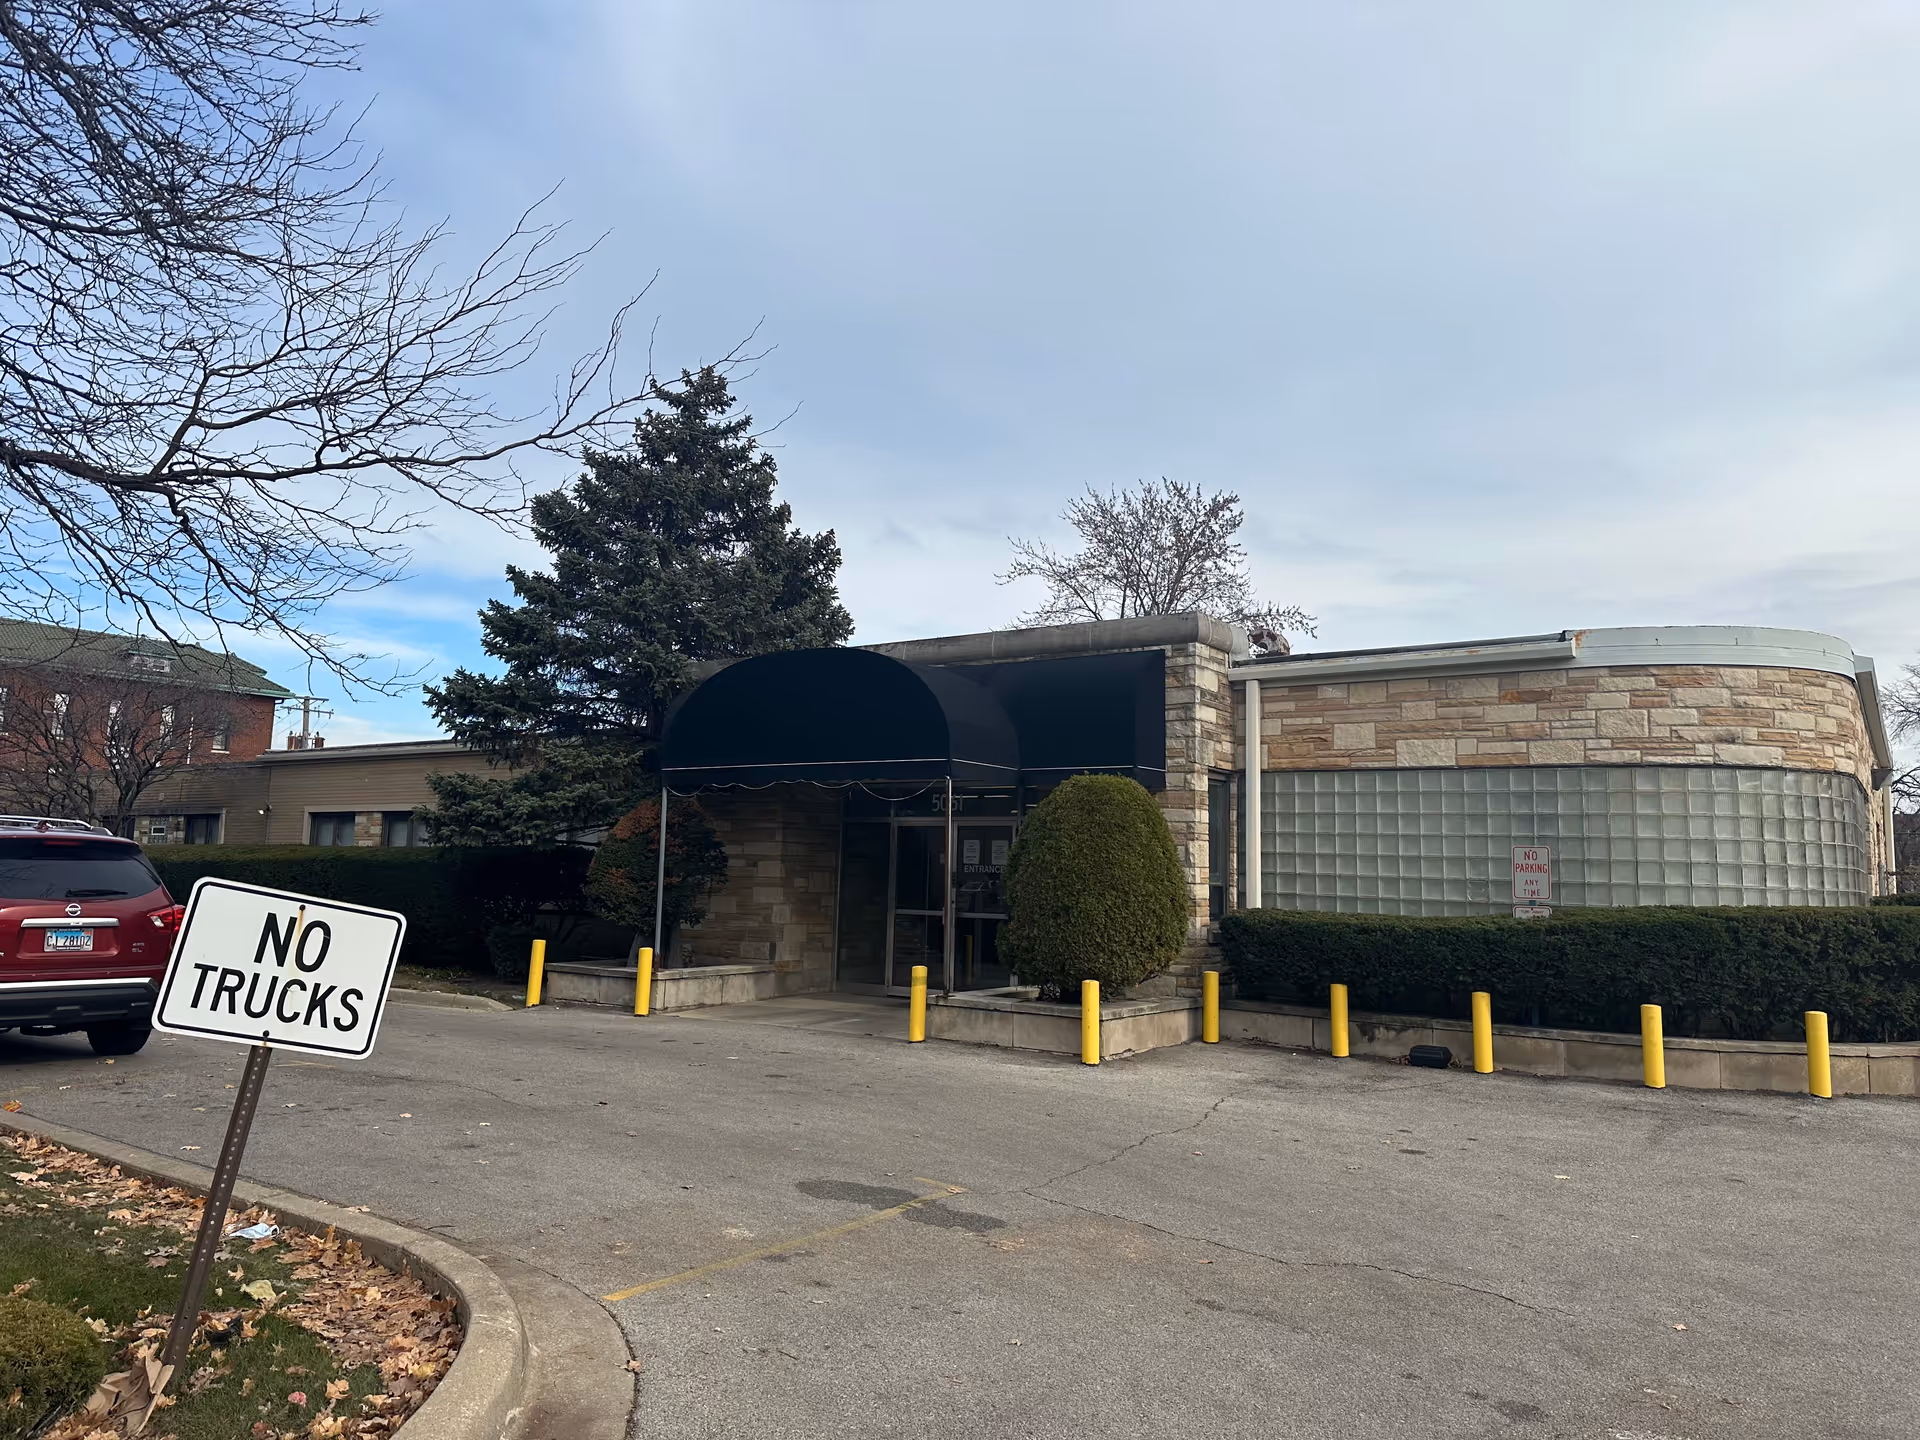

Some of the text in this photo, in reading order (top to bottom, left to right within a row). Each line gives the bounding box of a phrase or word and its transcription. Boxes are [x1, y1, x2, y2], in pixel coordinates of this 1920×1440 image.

[1524, 851, 1537, 861] NO
[964, 865, 1005, 873] ENTRANCE
[1515, 863, 1548, 874] PARKING
[254, 912, 331, 972] NO
[190, 962, 364, 1032] TRUCKS
